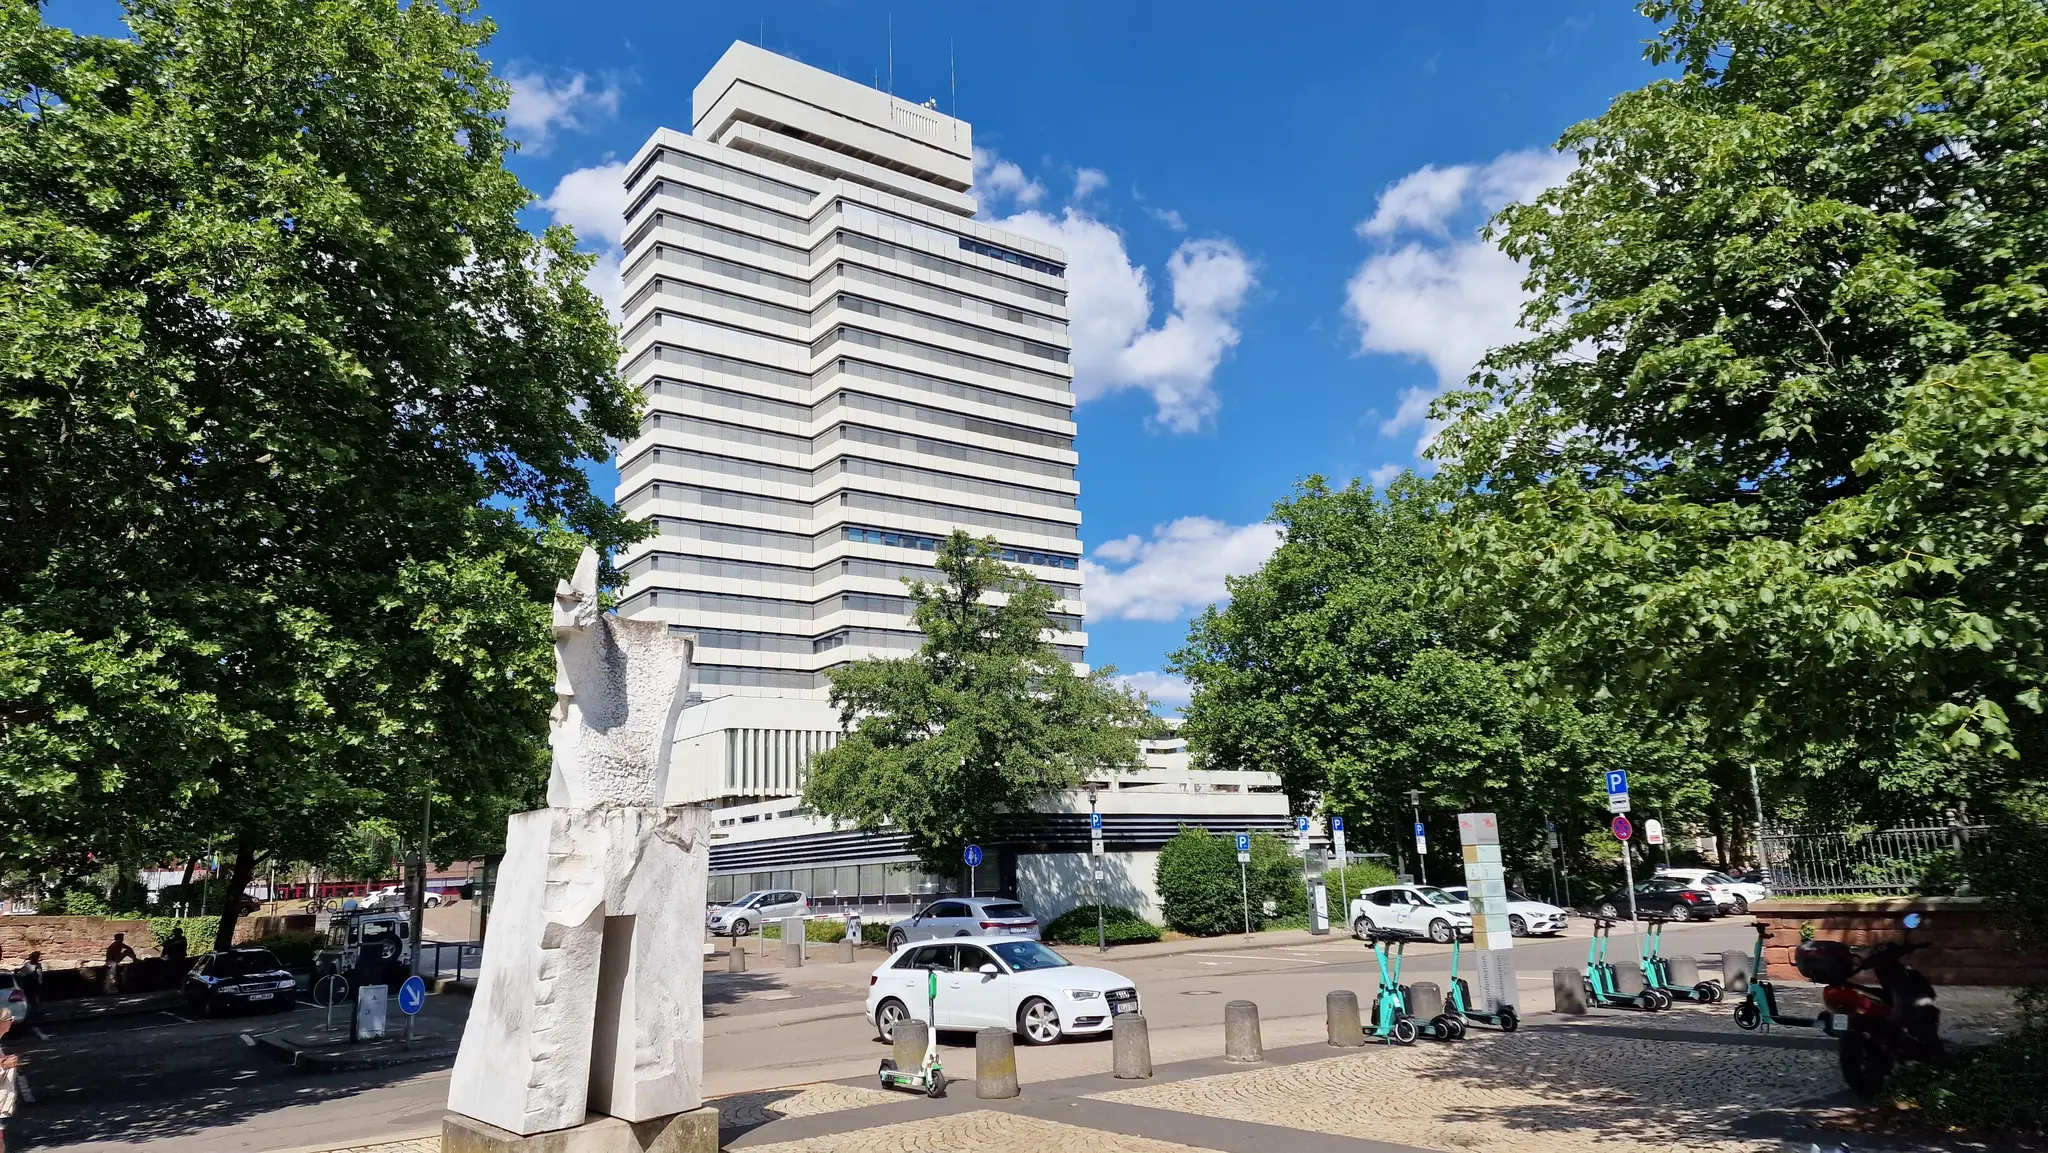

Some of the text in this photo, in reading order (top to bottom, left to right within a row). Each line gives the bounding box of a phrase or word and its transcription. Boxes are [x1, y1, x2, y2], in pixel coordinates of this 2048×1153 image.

[1610, 774, 1622, 792] P
[1092, 815, 1099, 827] P
[1300, 818, 1306, 830] P
[1334, 819, 1341, 830] P
[1416, 824, 1423, 835] P
[1239, 836, 1246, 848] P
